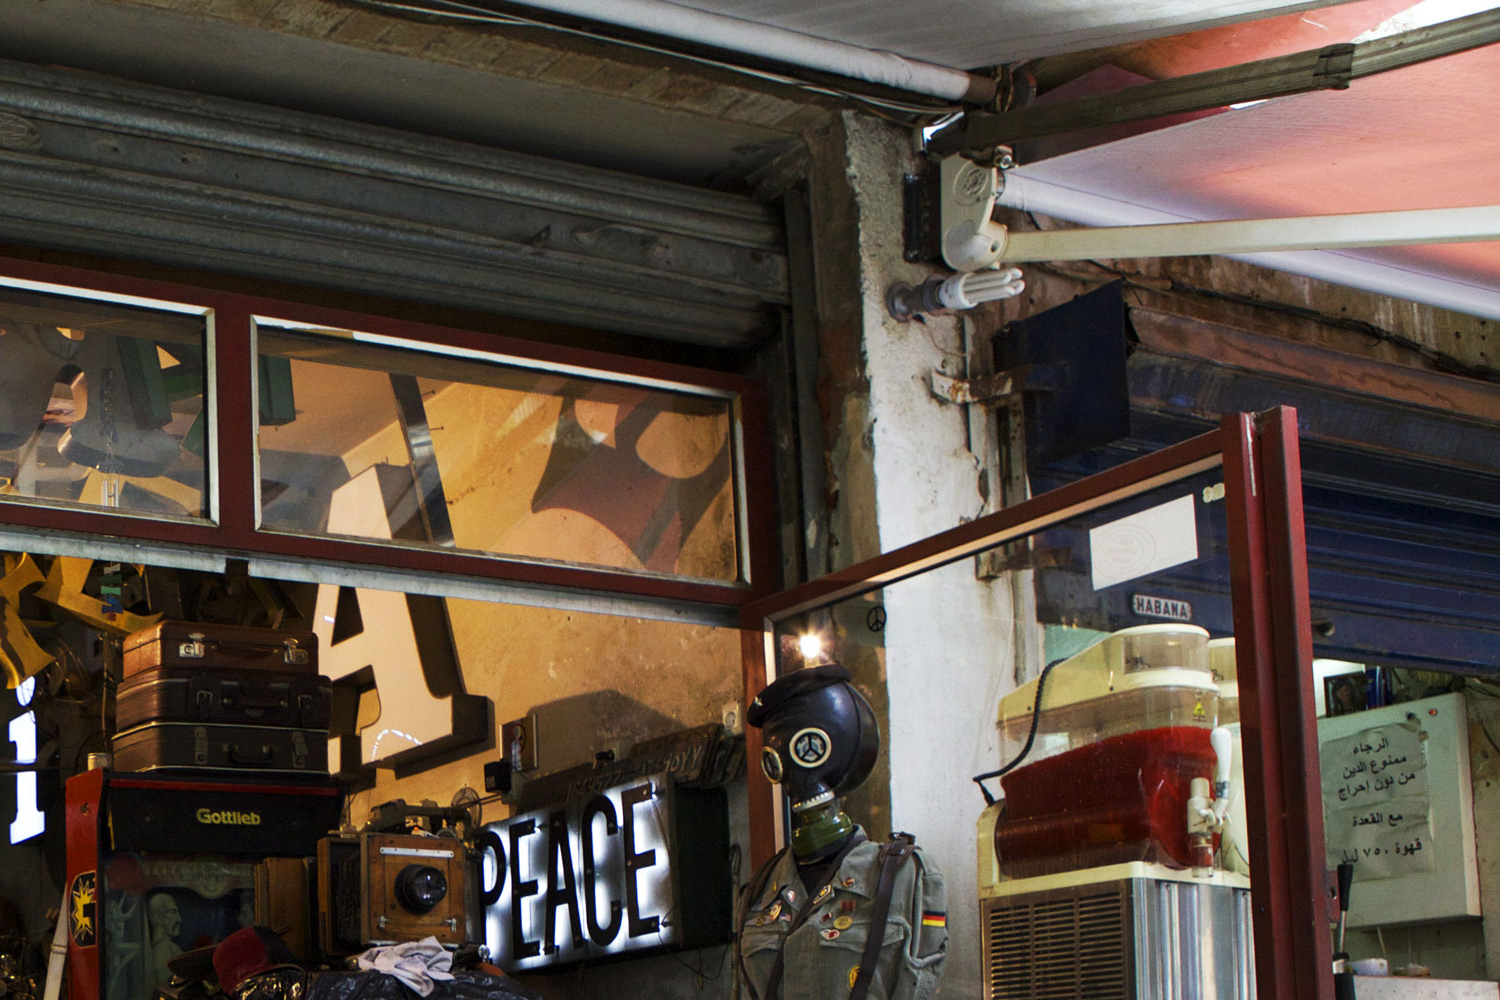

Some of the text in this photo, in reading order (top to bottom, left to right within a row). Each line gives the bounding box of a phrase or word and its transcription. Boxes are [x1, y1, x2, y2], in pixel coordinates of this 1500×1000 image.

[1137, 597, 1188, 618] HABANA
[1353, 737, 1389, 755] الرجاء
[1370, 755, 1407, 774] ممنوع
[1374, 776, 1394, 791] دون
[1398, 772, 1415, 785] من
[196, 808, 261, 826] Gottlieb
[1352, 812, 1403, 827] مع القعدة
[1395, 837, 1422, 856] قهوة
[475, 783, 659, 961] PEACE
